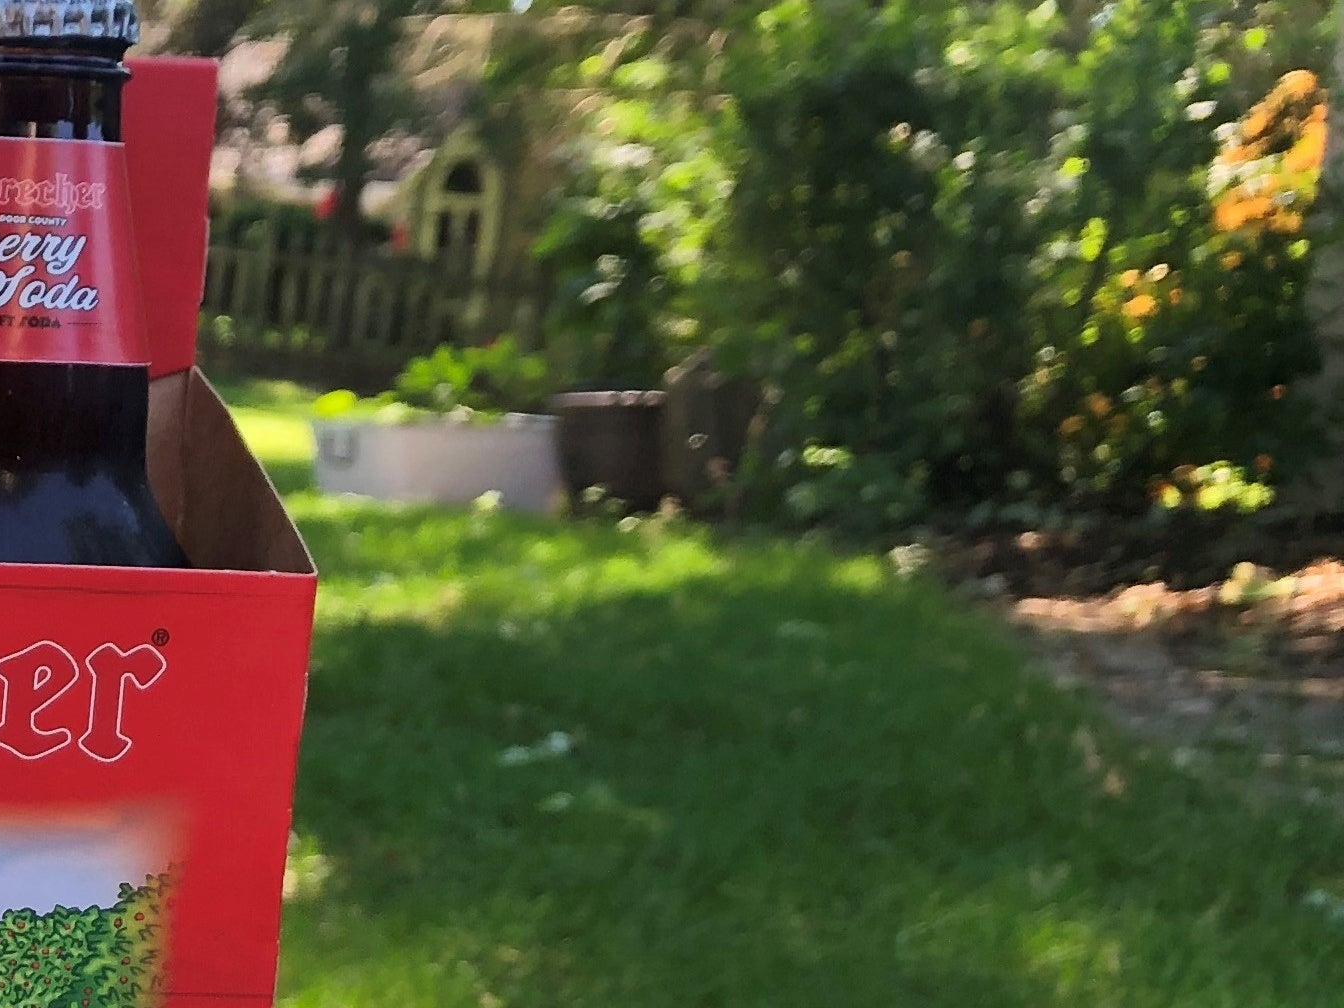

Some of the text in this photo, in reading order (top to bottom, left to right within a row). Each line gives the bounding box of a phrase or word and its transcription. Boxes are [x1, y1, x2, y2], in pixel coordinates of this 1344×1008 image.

[0, 213, 68, 227] DOOR COUNTY
[19, 314, 62, 329] SODA
